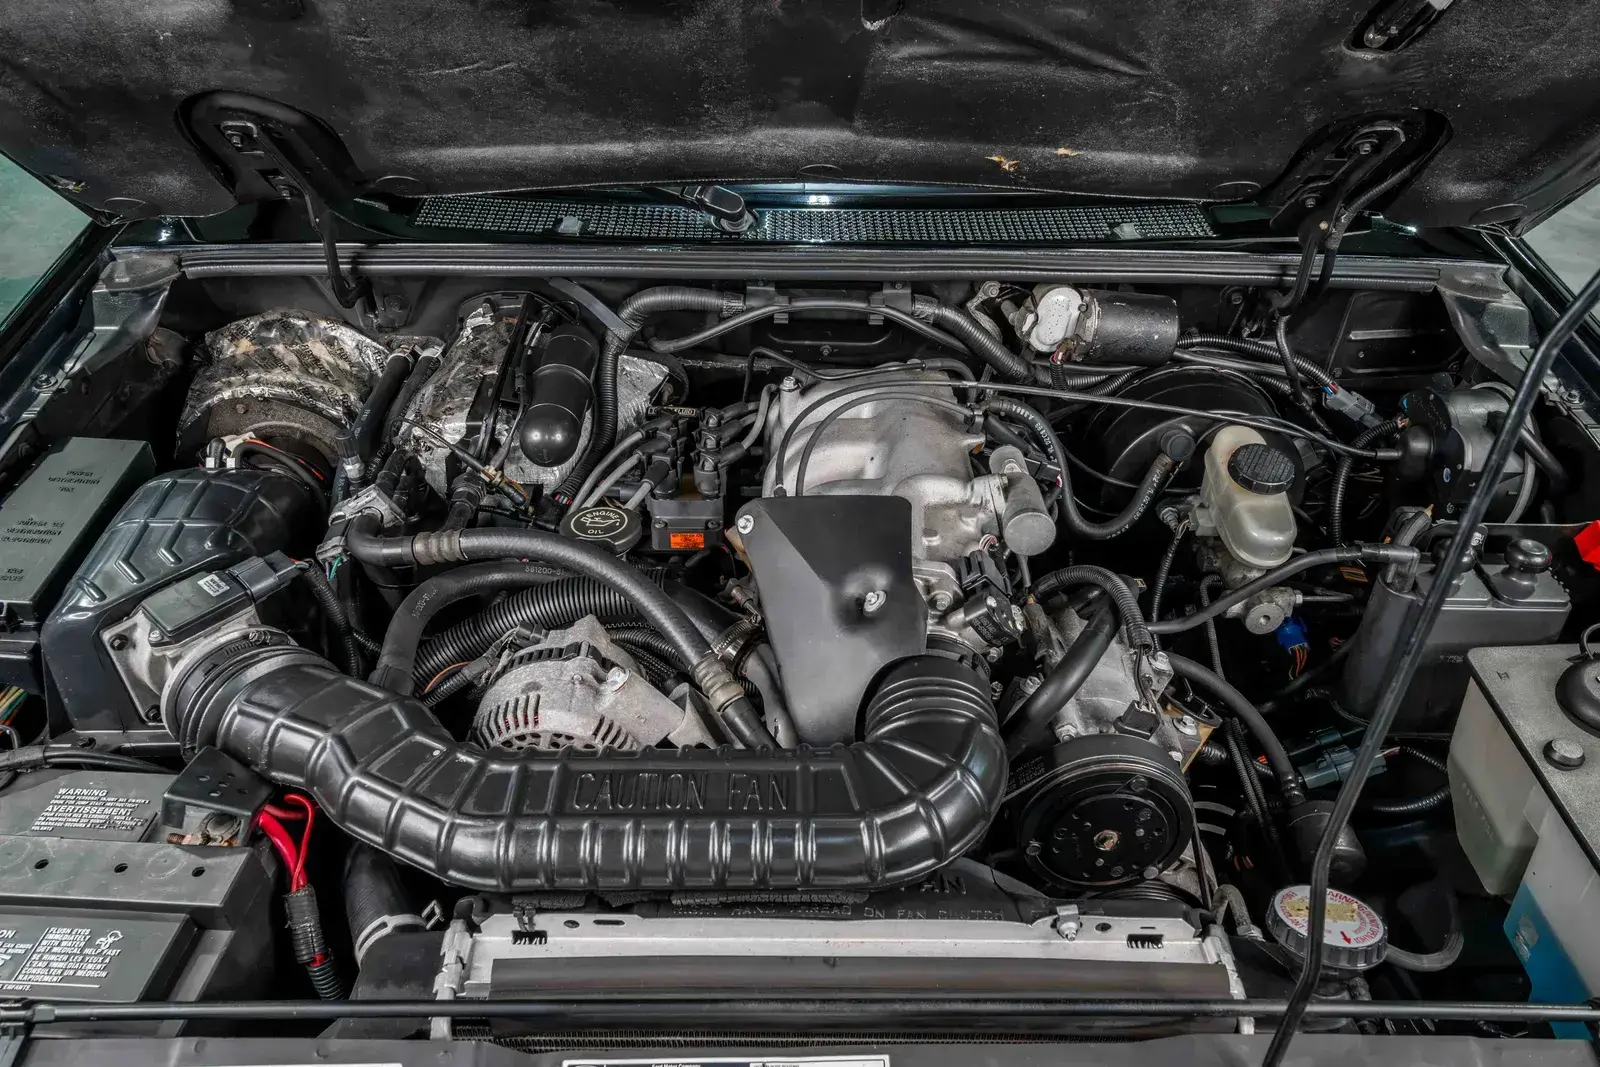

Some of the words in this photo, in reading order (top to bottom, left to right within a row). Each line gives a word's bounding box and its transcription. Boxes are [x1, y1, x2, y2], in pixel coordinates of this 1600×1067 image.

[586, 510, 620, 520] ENGINE
[58, 788, 108, 797] WARNING
[574, 773, 707, 810] CAUTION
[728, 773, 788, 810] FAN
[44, 805, 133, 816] AVERTISSEMENT
[863, 907, 886, 919] ON
[897, 909, 927, 920] FAN
[48, 927, 73, 935] FLUSH
[85, 955, 103, 963] YEUX
